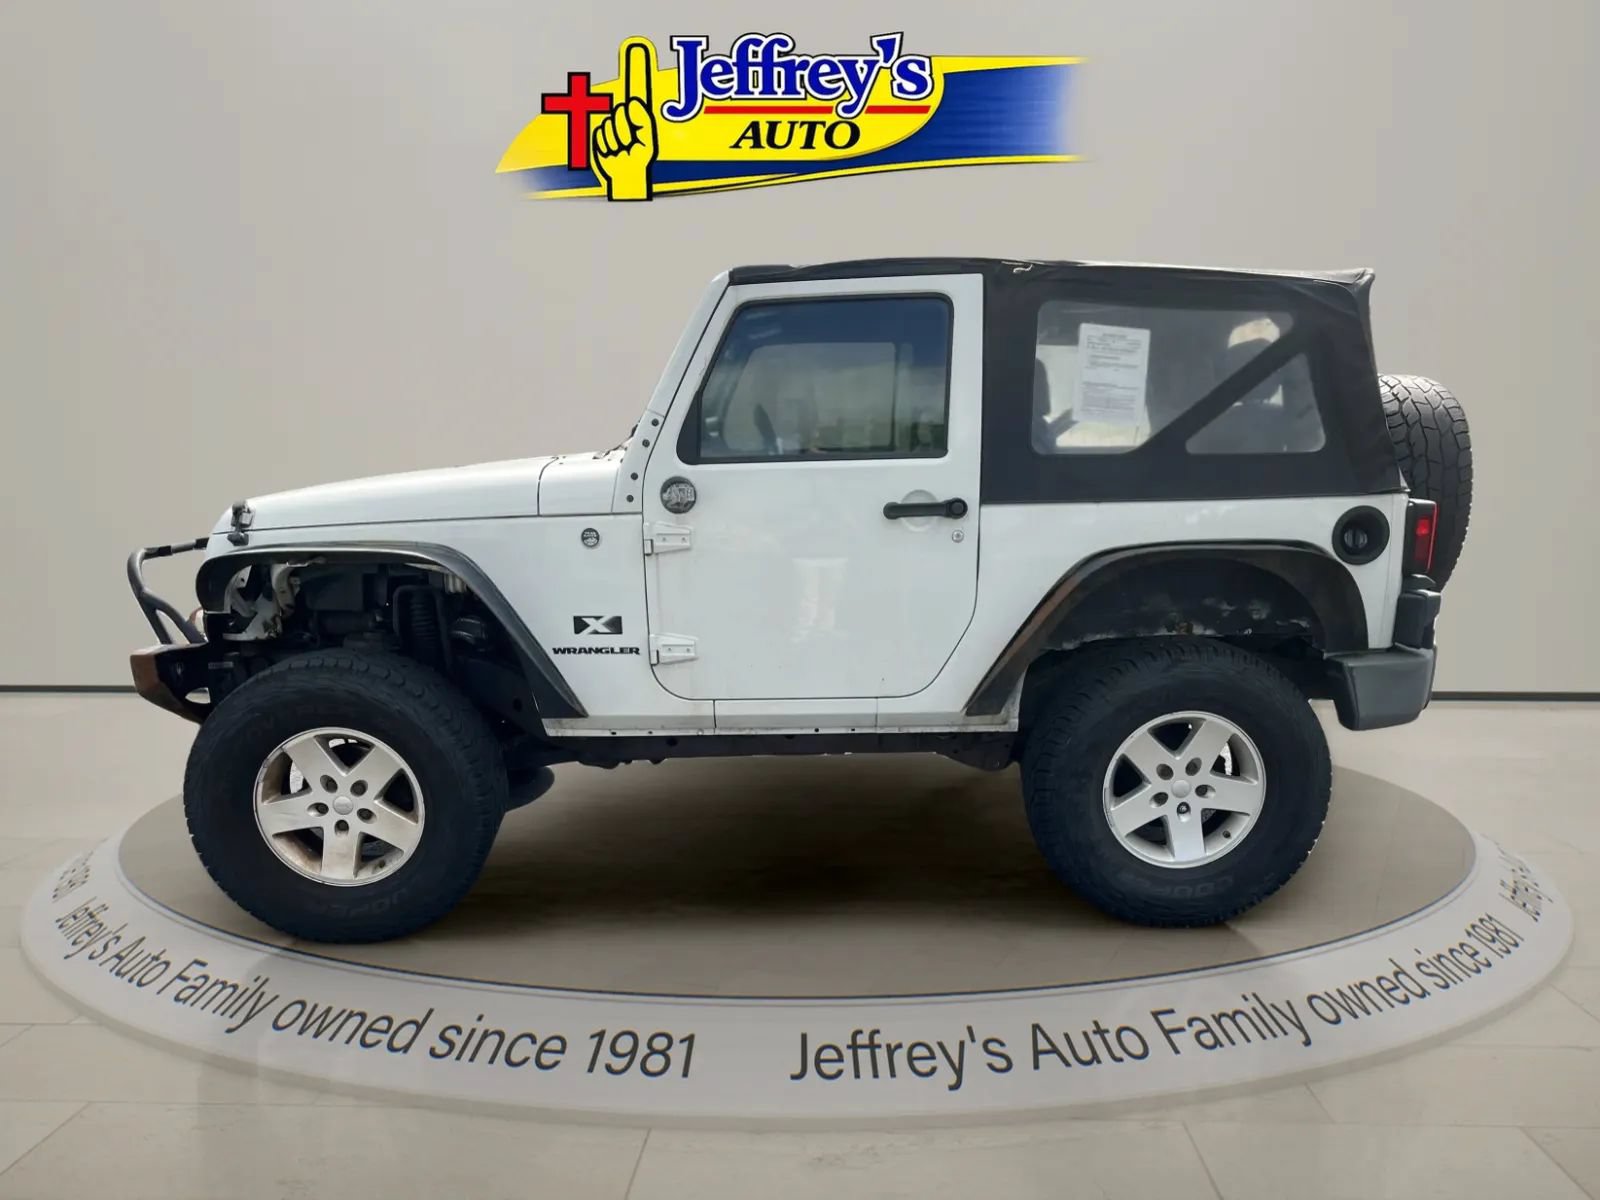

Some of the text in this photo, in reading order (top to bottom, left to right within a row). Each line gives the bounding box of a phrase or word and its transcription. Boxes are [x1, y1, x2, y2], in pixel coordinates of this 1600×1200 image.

[664, 32, 934, 121] Jeffrey's
[729, 120, 861, 149] AUTO
[552, 646, 640, 655] WRANGLER
[55, 896, 696, 1078] Jeffrey's Auto Family owned since 1981
[790, 912, 1525, 1091] Jeffrey's Auto Family owned since 1981
